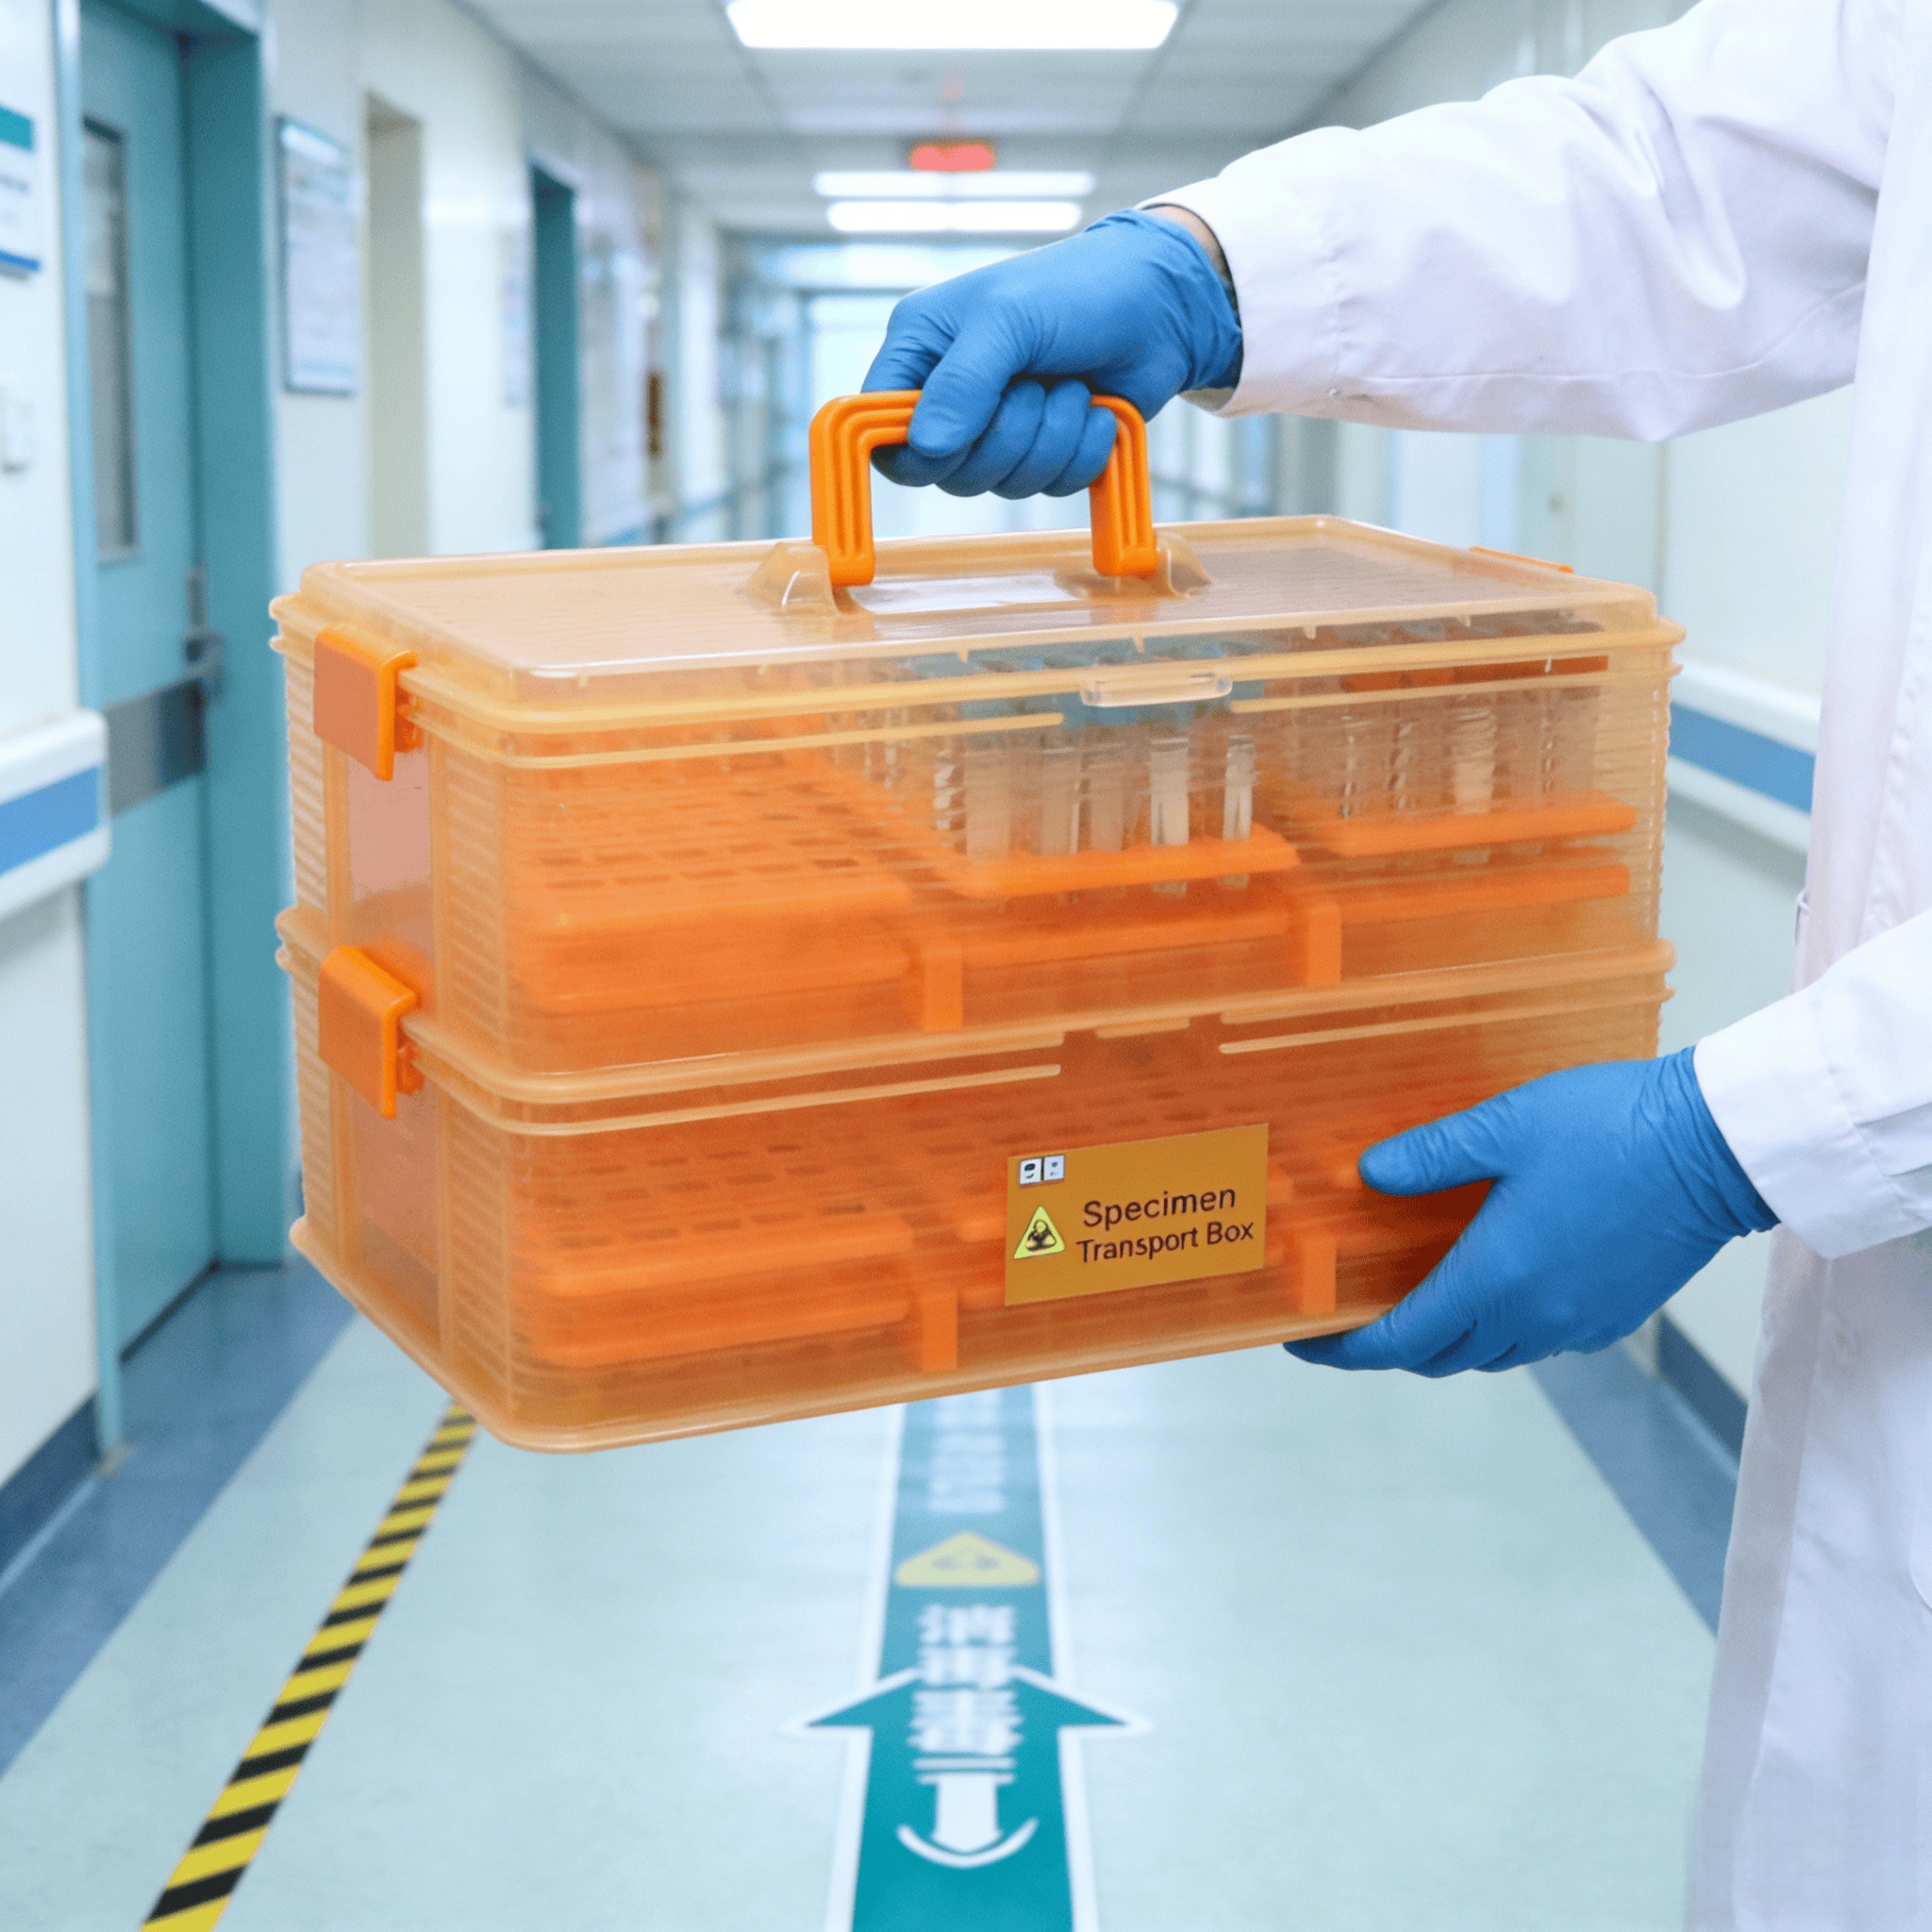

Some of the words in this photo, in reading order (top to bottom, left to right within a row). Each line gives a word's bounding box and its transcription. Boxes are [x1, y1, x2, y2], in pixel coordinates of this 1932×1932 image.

[1083, 1189, 1236, 1230] Specimen
[1076, 1227, 1199, 1263] Transport
[1206, 1221, 1254, 1245] Box
